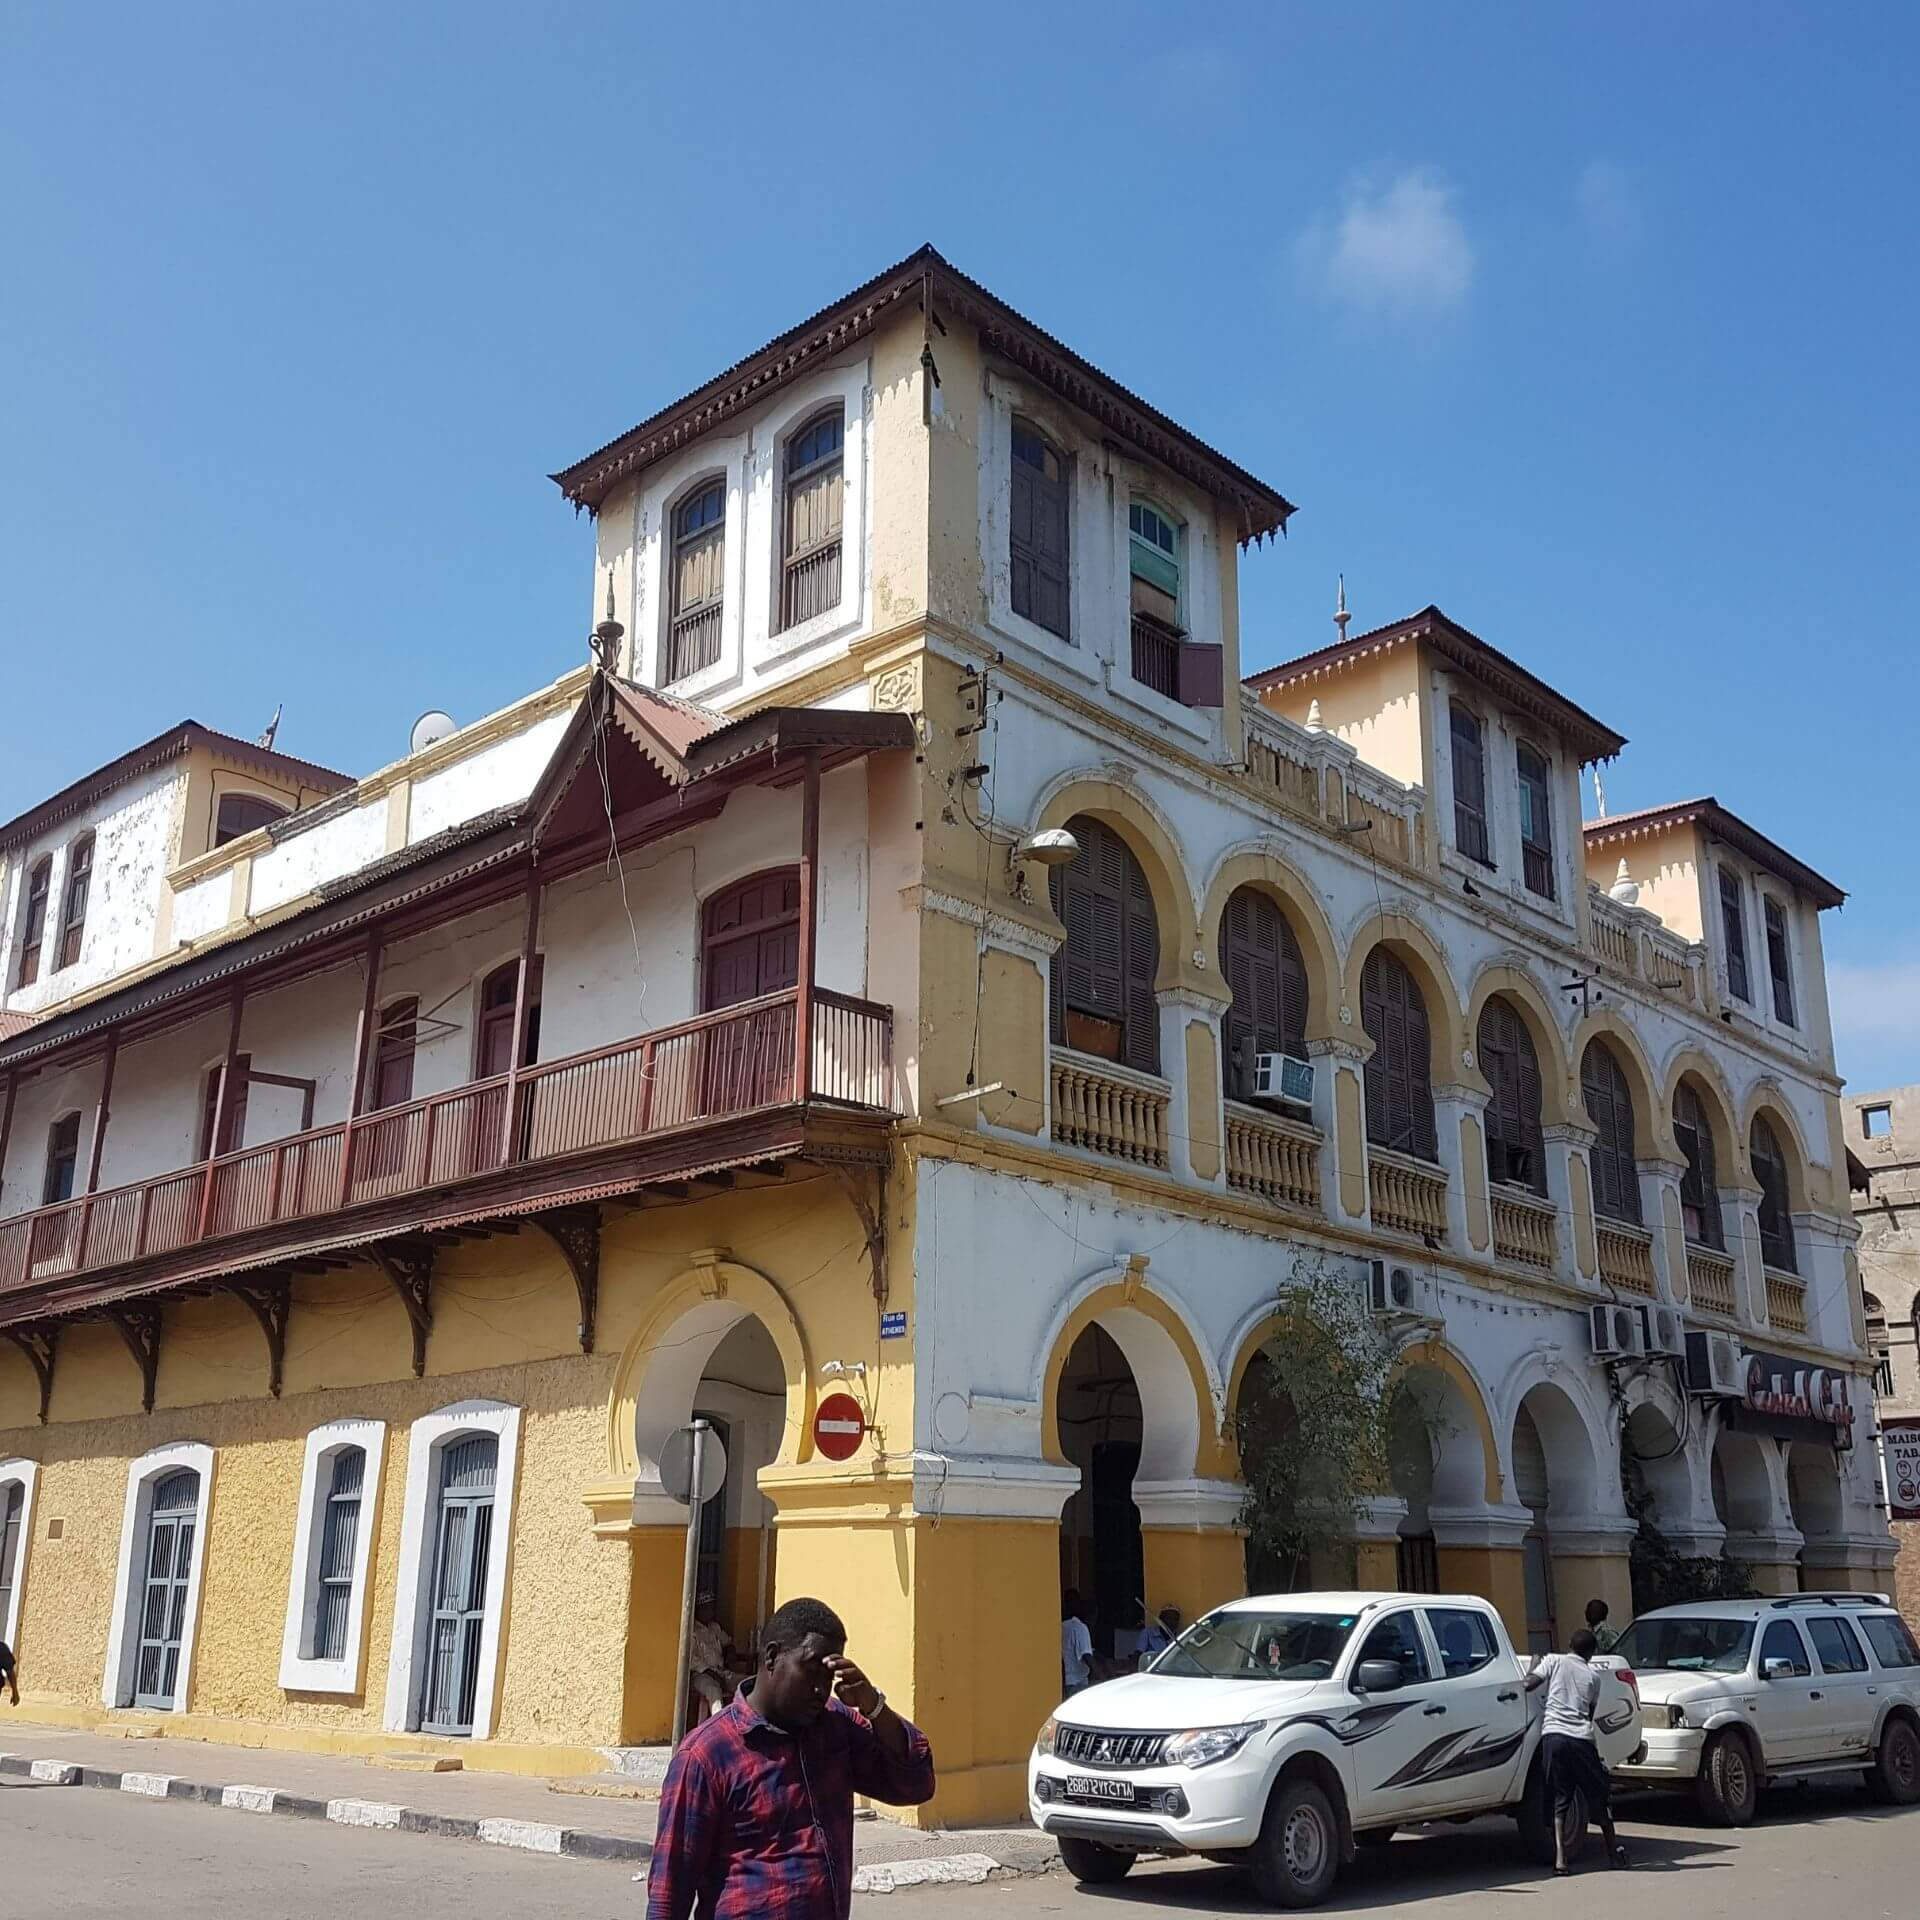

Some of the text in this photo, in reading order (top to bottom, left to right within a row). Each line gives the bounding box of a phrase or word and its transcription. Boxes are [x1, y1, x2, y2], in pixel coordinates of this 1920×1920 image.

[882, 1314, 895, 1322] Rue
[1887, 1433, 1920, 1444] MAIS
[1894, 1447, 1920, 1458] TAB
